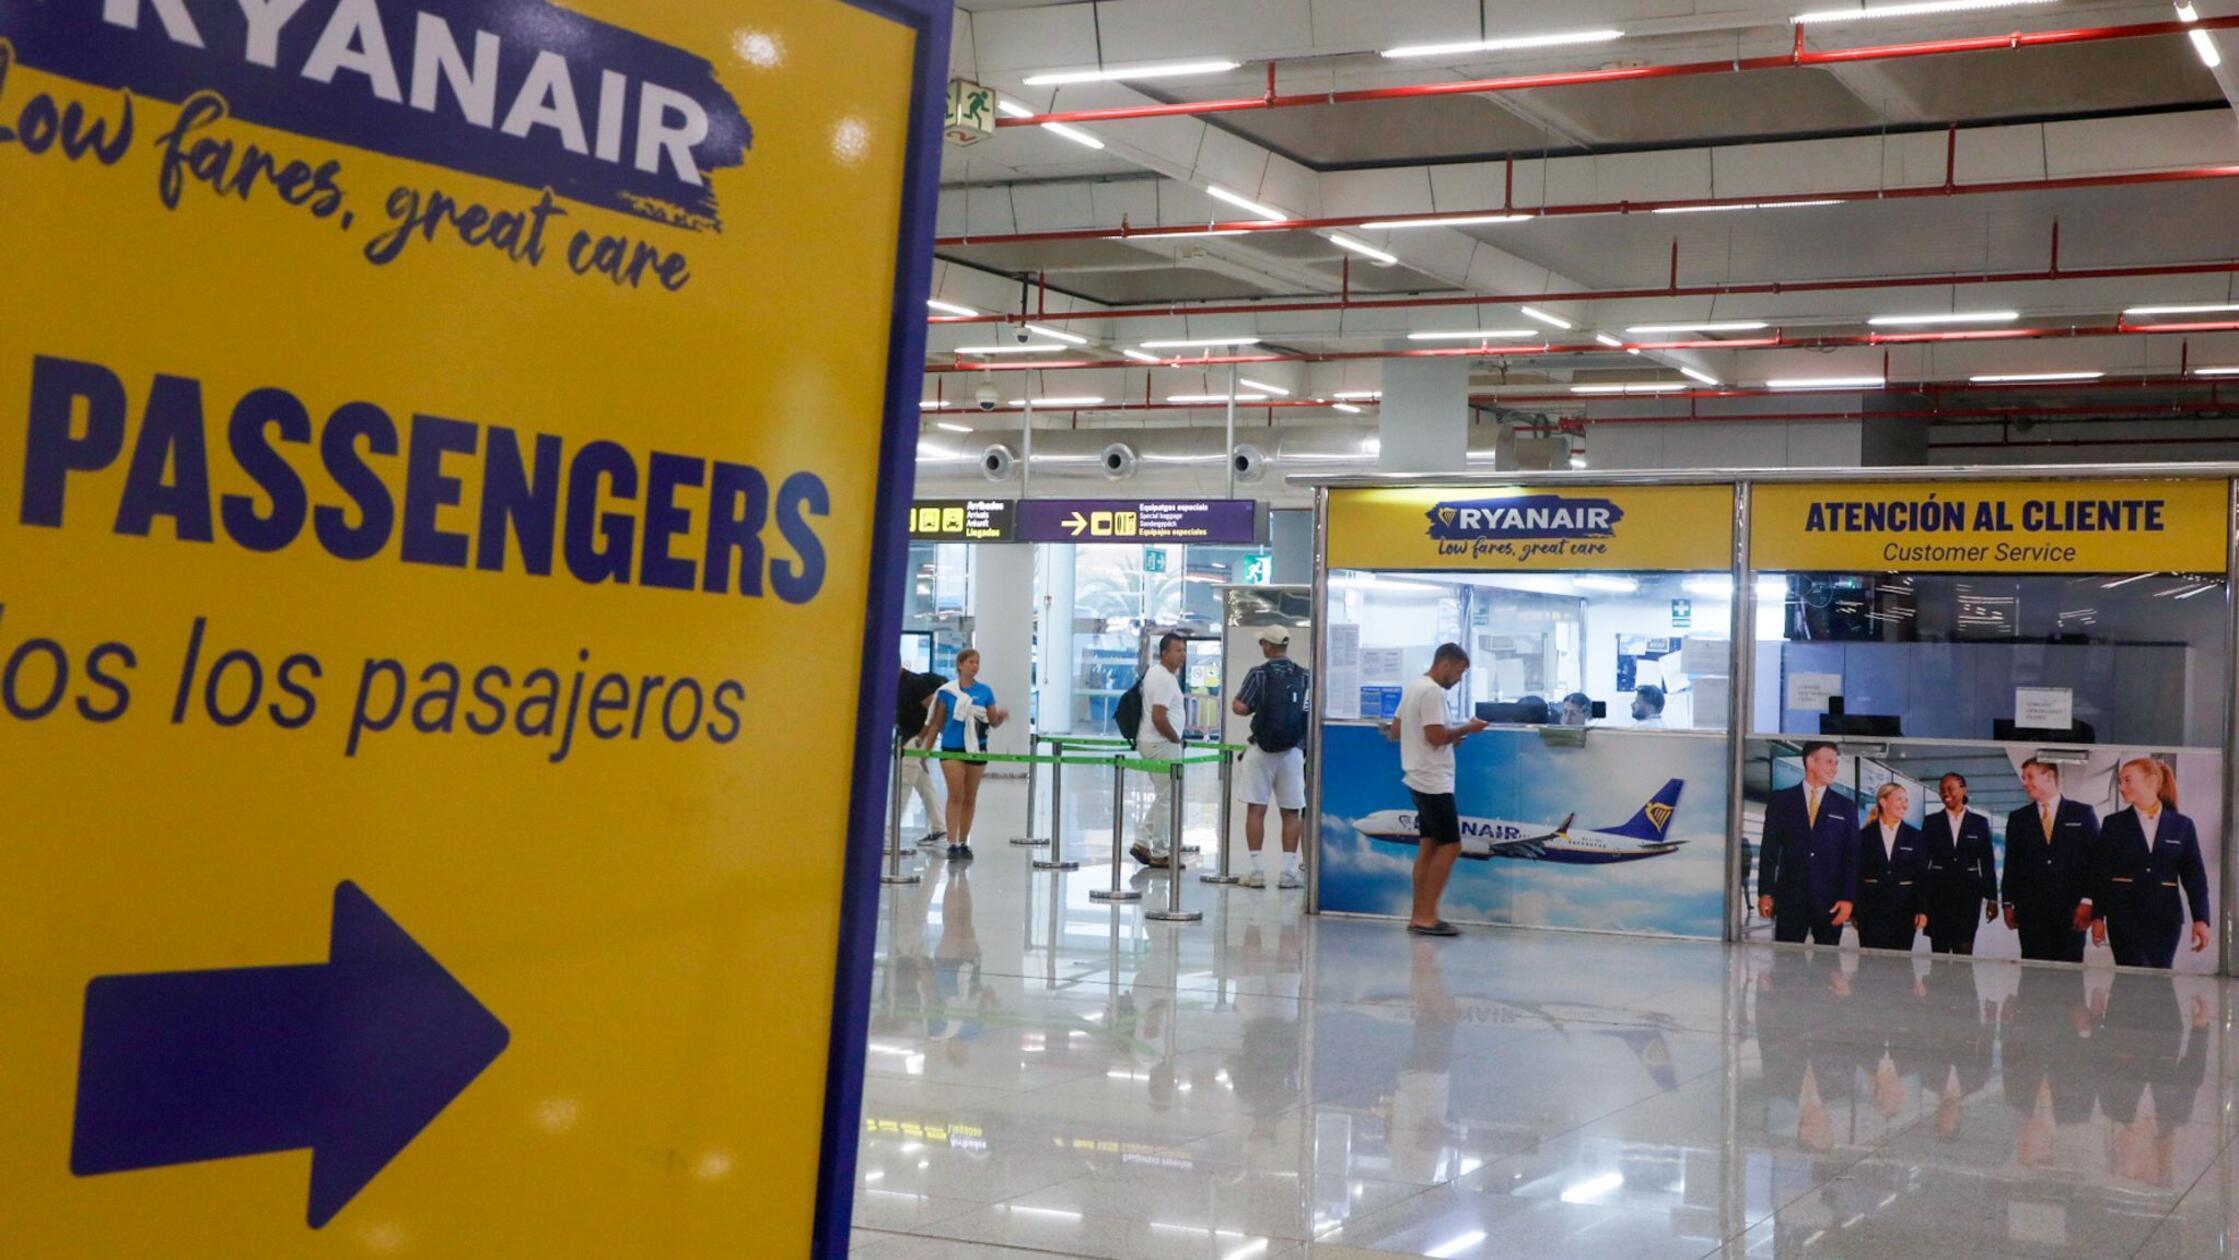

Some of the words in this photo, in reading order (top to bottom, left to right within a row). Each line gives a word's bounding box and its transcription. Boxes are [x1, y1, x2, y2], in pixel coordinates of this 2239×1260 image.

[155, 90, 355, 231] fares,
[363, 188, 567, 267] great
[567, 229, 690, 292] care
[20, 355, 830, 604] PASSENGERS
[1460, 508, 1611, 529] RYANAIR
[1805, 493, 1965, 532] ATENCIÓN
[1972, 501, 2014, 532] AL
[2022, 500, 2165, 532] CLIENTE
[966, 527, 1001, 539] Llegadas
[1438, 536, 1468, 555] Low
[1472, 536, 1516, 560] fares,
[1519, 537, 1569, 561] great
[1570, 543, 1607, 555] care
[1883, 542, 1989, 562] Customer
[1994, 542, 2077, 562] Service
[171, 617, 323, 728] los
[345, 649, 745, 763] pasajeros
